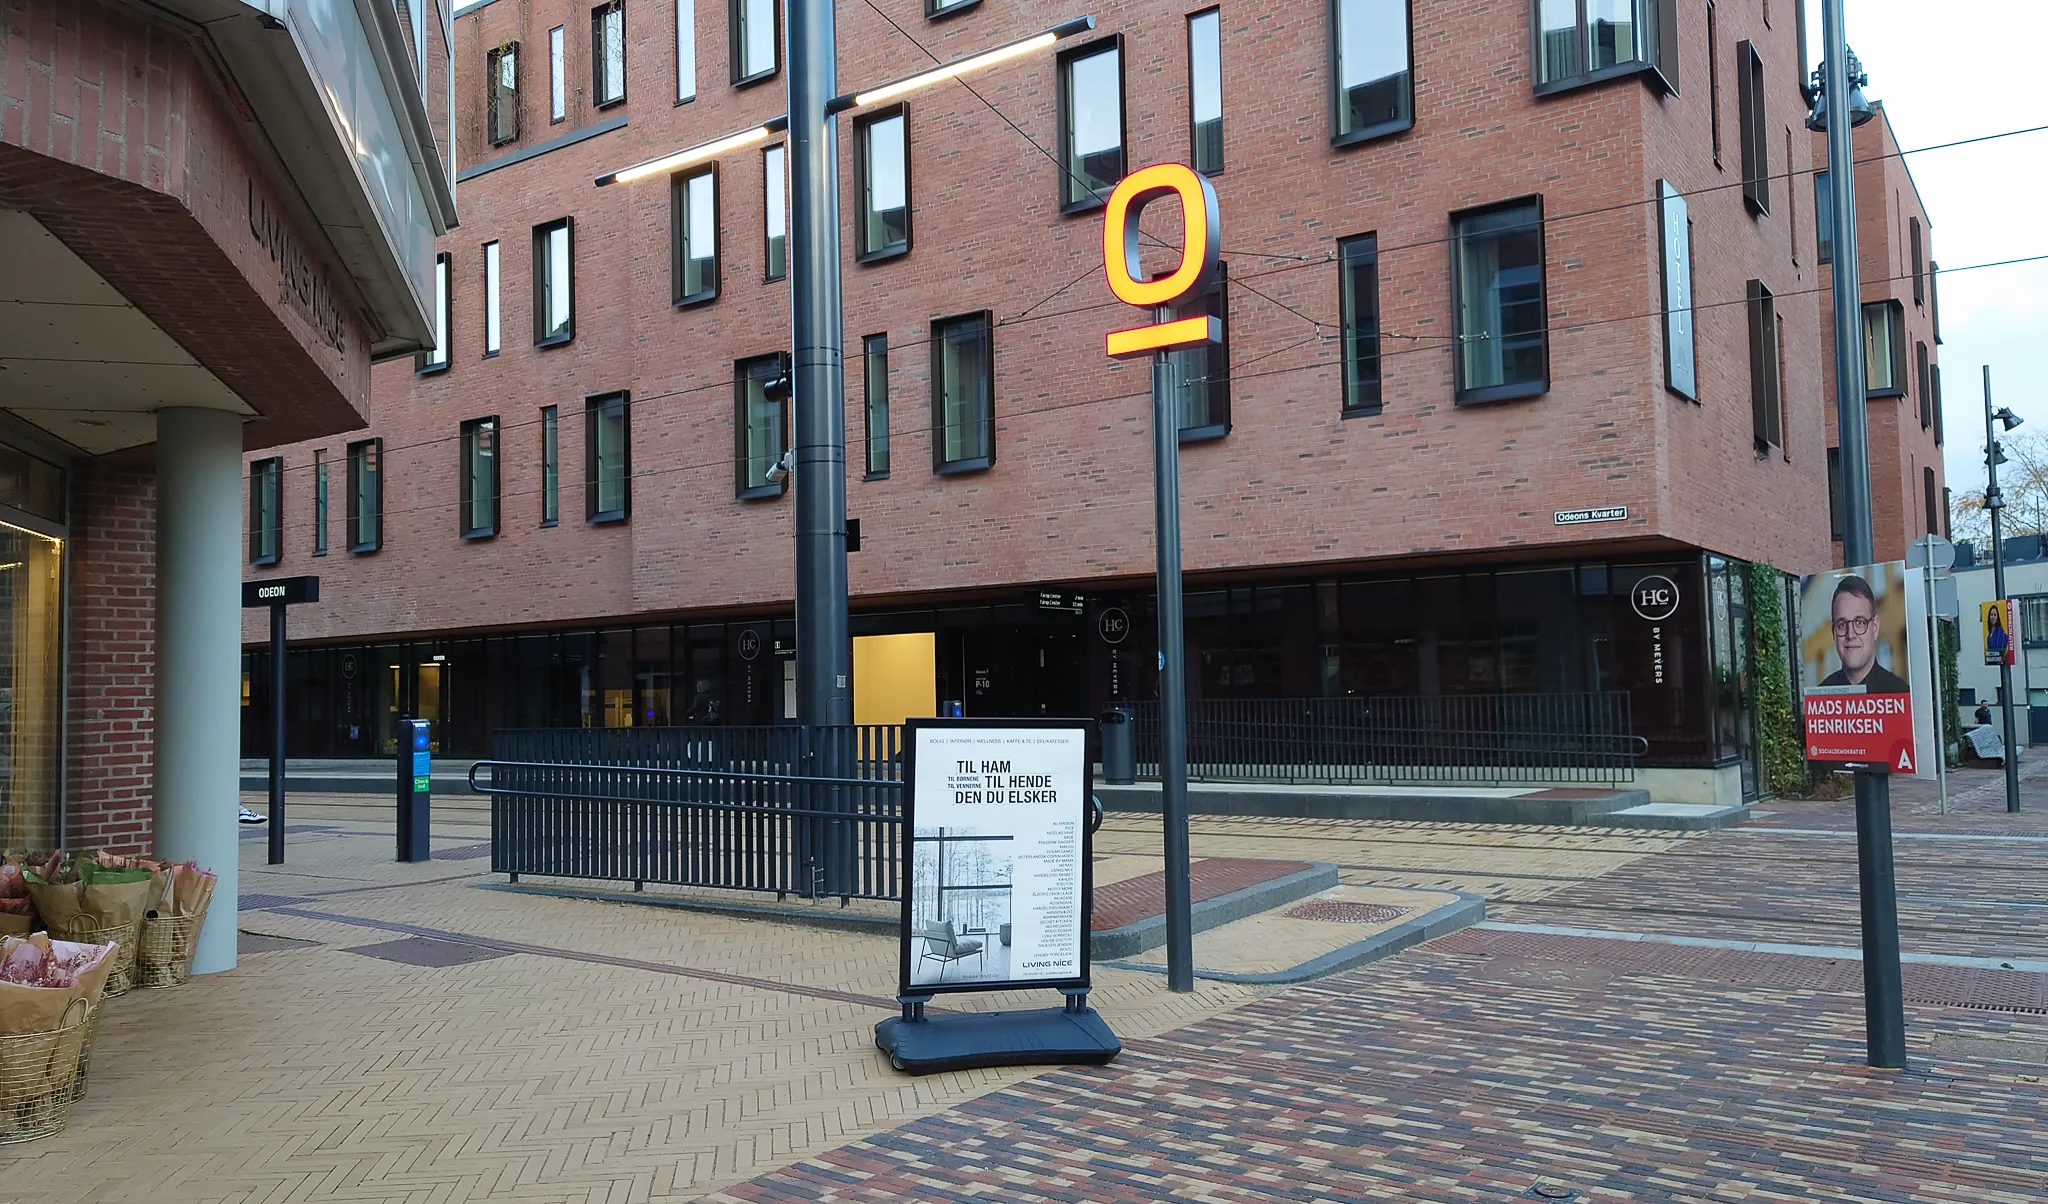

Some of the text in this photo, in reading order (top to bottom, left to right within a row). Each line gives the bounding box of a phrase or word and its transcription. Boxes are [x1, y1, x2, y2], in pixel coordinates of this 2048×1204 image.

[248, 179, 312, 307] LIVING
[312, 276, 345, 354] NICE
[1673, 211, 1684, 335] HOTEL
[1557, 509, 1624, 522] Odeons Kvarter
[258, 586, 286, 599] ODEON
[1640, 589, 1669, 606] HC
[1105, 619, 1123, 632] HC
[742, 639, 756, 650] HC
[1653, 627, 1663, 684] BY MEYERS
[975, 680, 990, 688] P-10
[1807, 697, 1905, 716] MADS MADSEN
[1808, 718, 1884, 734] HENRIKSEN
[1818, 747, 1866, 756] SOCIALDEMOKRATIET
[1897, 748, 1913, 770] A
[957, 760, 1011, 773] TIL HAM
[985, 775, 1052, 788] TIL HENDE
[955, 790, 1057, 804] DEN DU ELSKER
